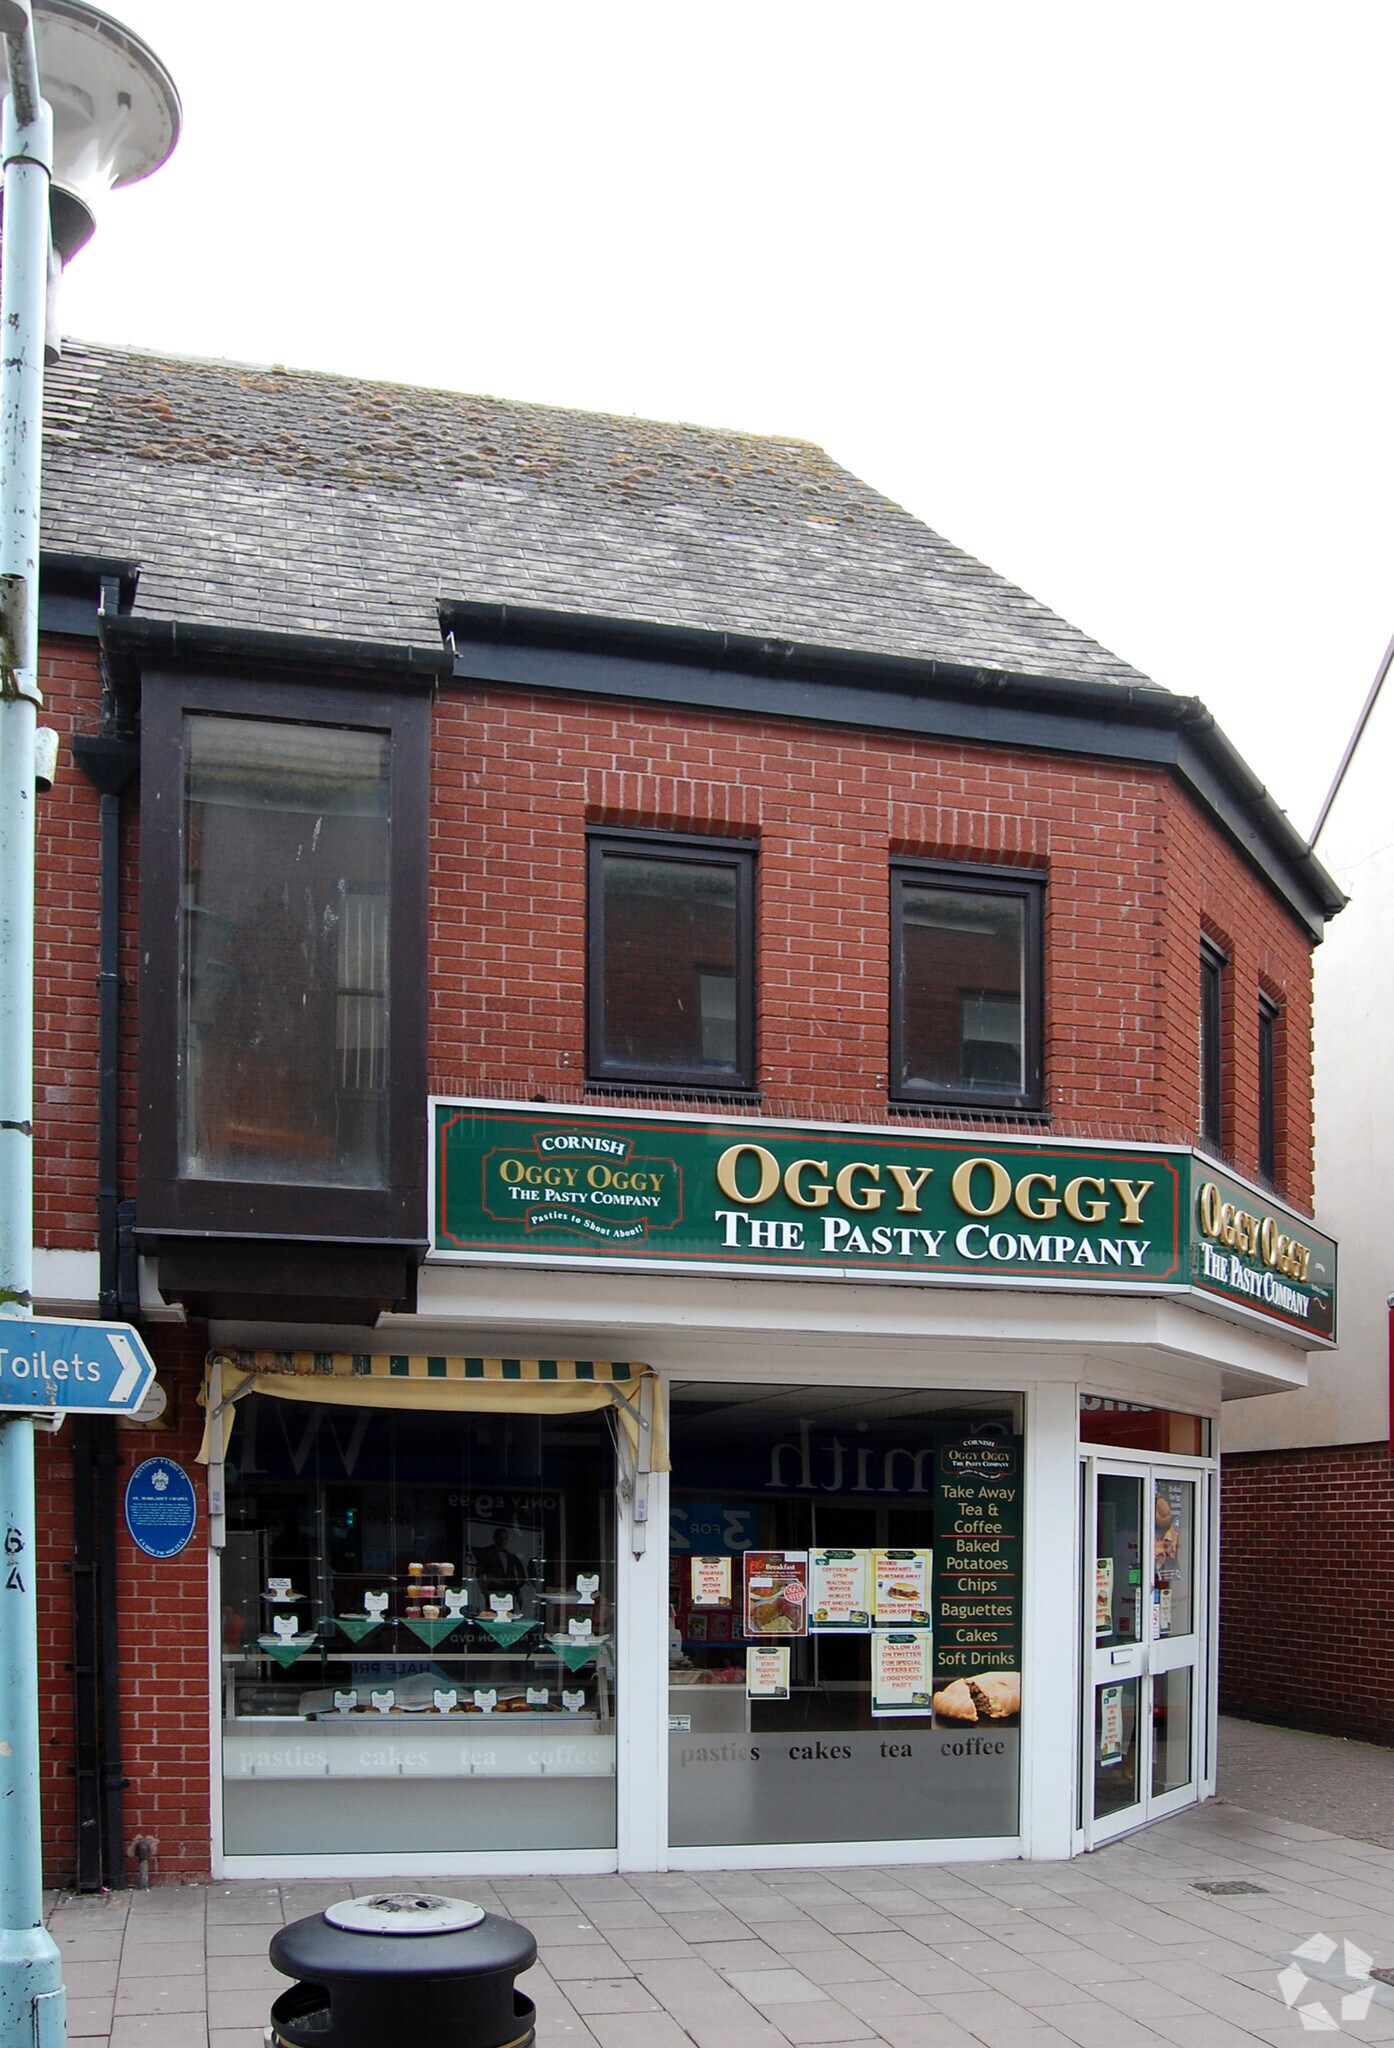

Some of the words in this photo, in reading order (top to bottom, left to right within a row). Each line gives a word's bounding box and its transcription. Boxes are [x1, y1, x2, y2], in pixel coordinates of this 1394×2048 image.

[541, 1136, 626, 1156] CORNISH
[500, 1159, 579, 1187] OGGY
[587, 1164, 665, 1192] OGGY
[717, 1143, 933, 1213] OGGY
[952, 1158, 1154, 1225] OGGY
[508, 1186, 540, 1201] THE
[544, 1189, 588, 1204] PASTY
[590, 1191, 661, 1207] COMPANY
[531, 1210, 568, 1225] Pasties
[571, 1215, 581, 1224] to
[583, 1219, 610, 1236] Shout
[613, 1225, 644, 1238] About!
[1199, 1182, 1260, 1258] OGGY
[1261, 1216, 1311, 1283] OGGY
[715, 1210, 804, 1251] THE
[820, 1217, 946, 1258] PASTY
[955, 1224, 1151, 1267] COMPANY
[1199, 1241, 1228, 1283] THE
[1230, 1255, 1264, 1298] PASTY
[1263, 1271, 1310, 1318] COMPANY
[0, 1348, 101, 1382] Toilets
[948, 1450, 978, 1461] OGGY
[981, 1451, 1011, 1461] OGGY
[941, 1485, 974, 1498] Take
[978, 1486, 1015, 1502] Away
[958, 1503, 982, 1516] Tea
[988, 1503, 999, 1516] &
[954, 1520, 1002, 1534] Coffee
[5, 1528, 24, 1553] 6
[956, 1540, 1000, 1553] Baked
[946, 1557, 1009, 1570] Potatoes
[957, 1578, 997, 1594] Chips
[941, 1603, 1013, 1619] Baguettes
[956, 1629, 998, 1642] Cakes
[938, 1652, 967, 1665] Soft
[971, 1652, 1015, 1665] Drinks
[239, 1745, 328, 1772] pasties
[359, 1745, 430, 1767] cakes
[459, 1747, 497, 1767] tea
[527, 1744, 600, 1766] coffee
[681, 1742, 760, 1767] pasties
[788, 1741, 852, 1761] cakes
[879, 1740, 913, 1758] tea
[940, 1737, 1006, 1757] coffee
